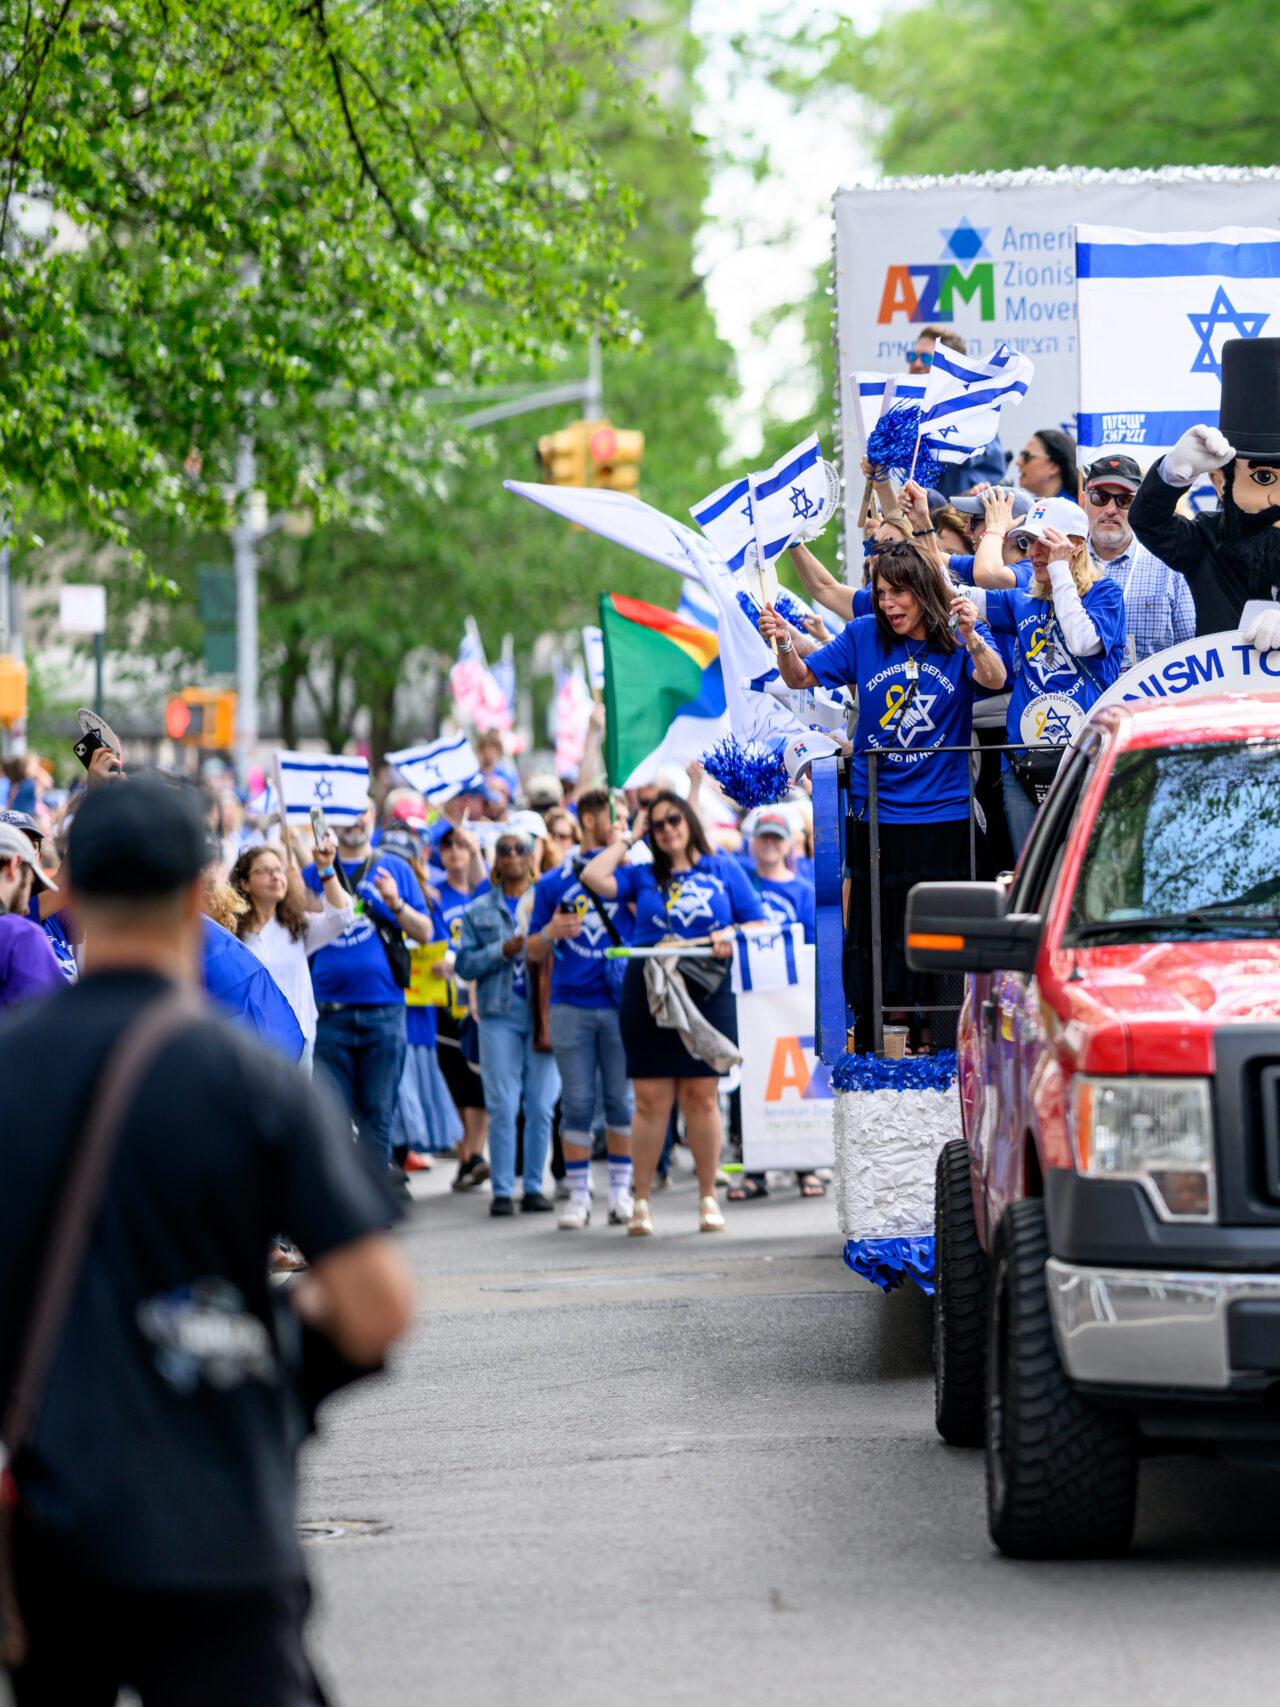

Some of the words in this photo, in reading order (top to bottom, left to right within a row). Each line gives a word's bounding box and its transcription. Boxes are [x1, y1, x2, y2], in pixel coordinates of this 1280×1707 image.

[1002, 226, 1072, 250] Ameri
[1003, 261, 1074, 287] Zionis
[877, 262, 995, 325] AZM
[919, 663, 956, 694] GETHER
[1122, 648, 1225, 701] NISM
[1023, 695, 1048, 719] ZIONISM
[1049, 694, 1083, 717] TOGETHER
[905, 753, 918, 763] IN
